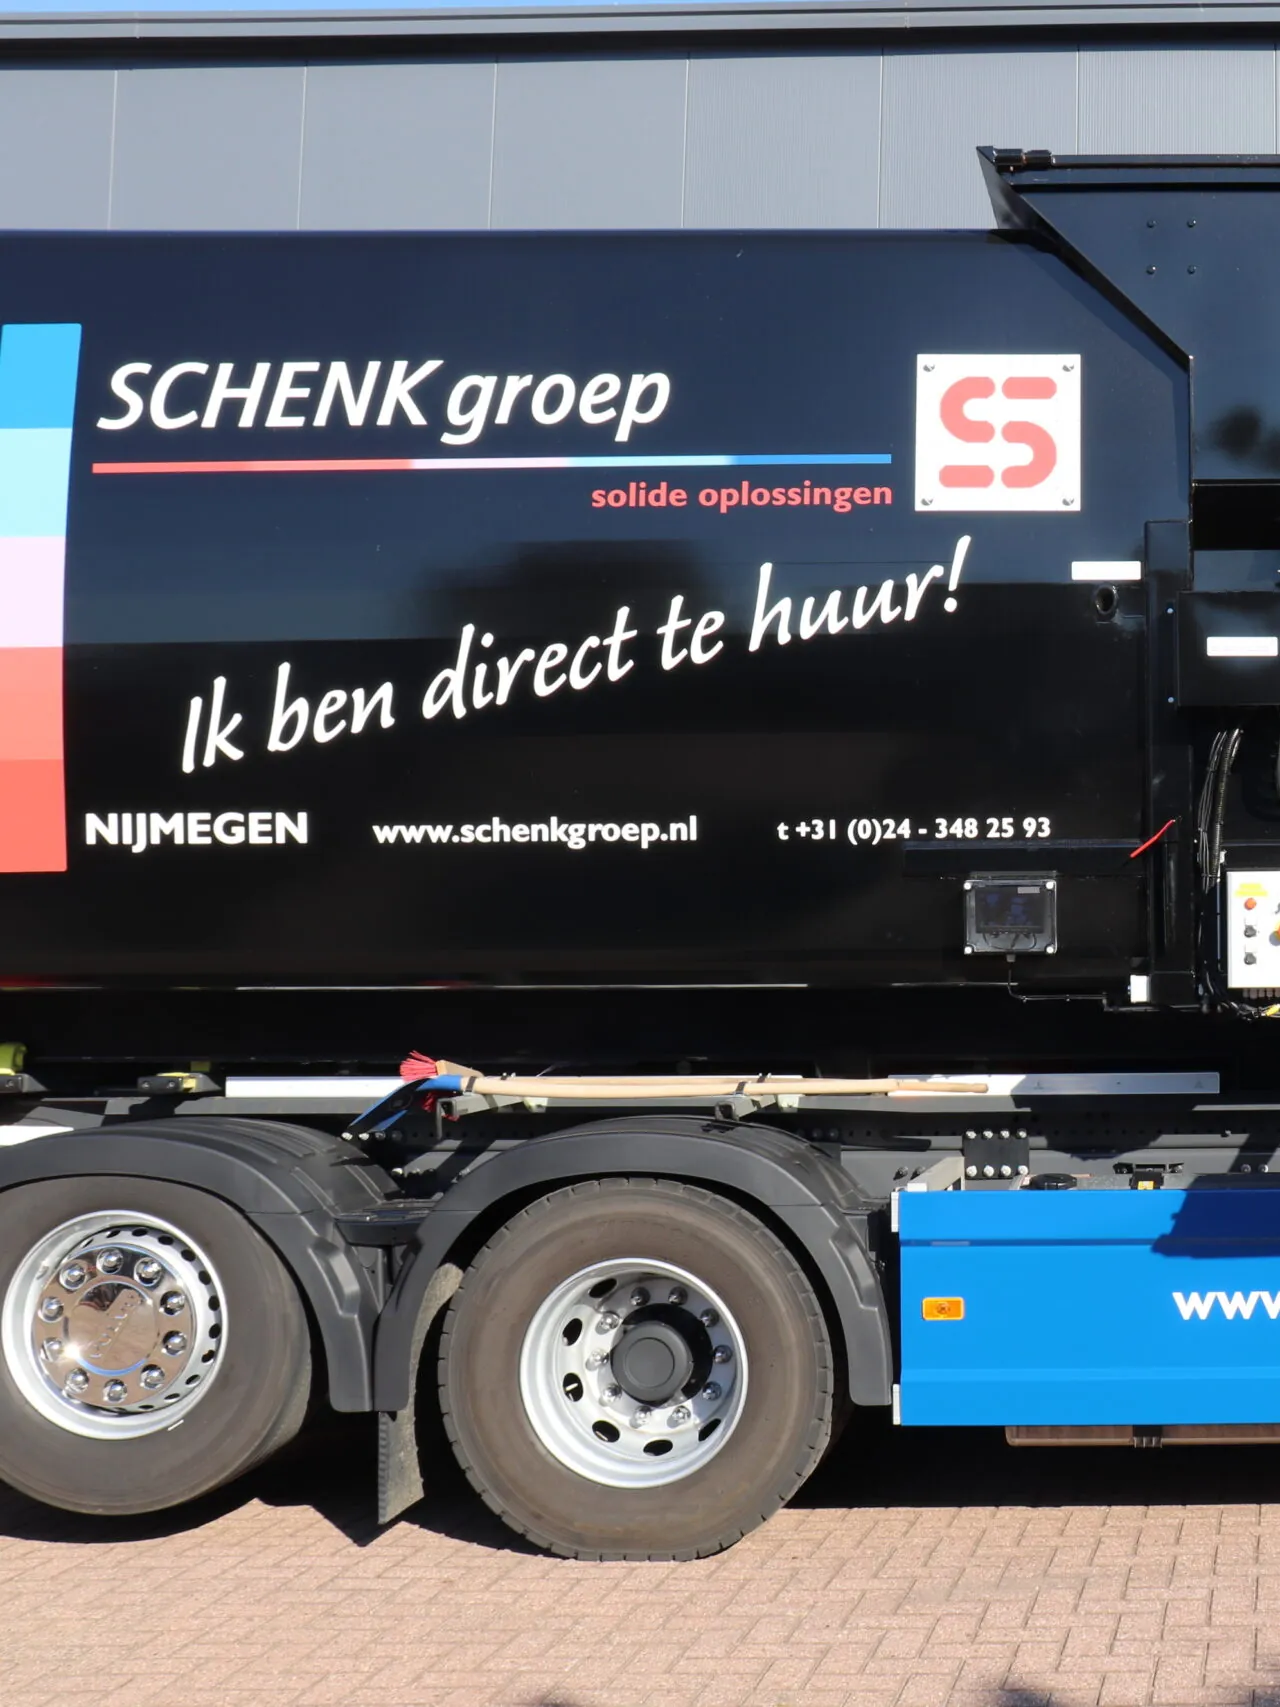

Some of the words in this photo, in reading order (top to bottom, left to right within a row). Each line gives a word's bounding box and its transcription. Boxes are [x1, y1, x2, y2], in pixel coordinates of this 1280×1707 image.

[96, 359, 444, 431] SCHENK
[440, 371, 671, 446] groep
[591, 481, 689, 509] solide
[698, 479, 893, 514] oplossingen
[182, 675, 245, 774] Ik
[267, 661, 396, 752] ben
[422, 605, 638, 720] direct
[656, 594, 725, 671] te
[748, 534, 972, 652] huur!
[85, 811, 308, 854] NIJMEGEN
[372, 815, 698, 850] www.schenkgroep.nl
[776, 822, 789, 841] t
[795, 819, 836, 840] +31
[847, 818, 911, 846] (0)24
[934, 817, 979, 839] 348
[986, 817, 1015, 838] 25
[1022, 816, 1051, 838] 93
